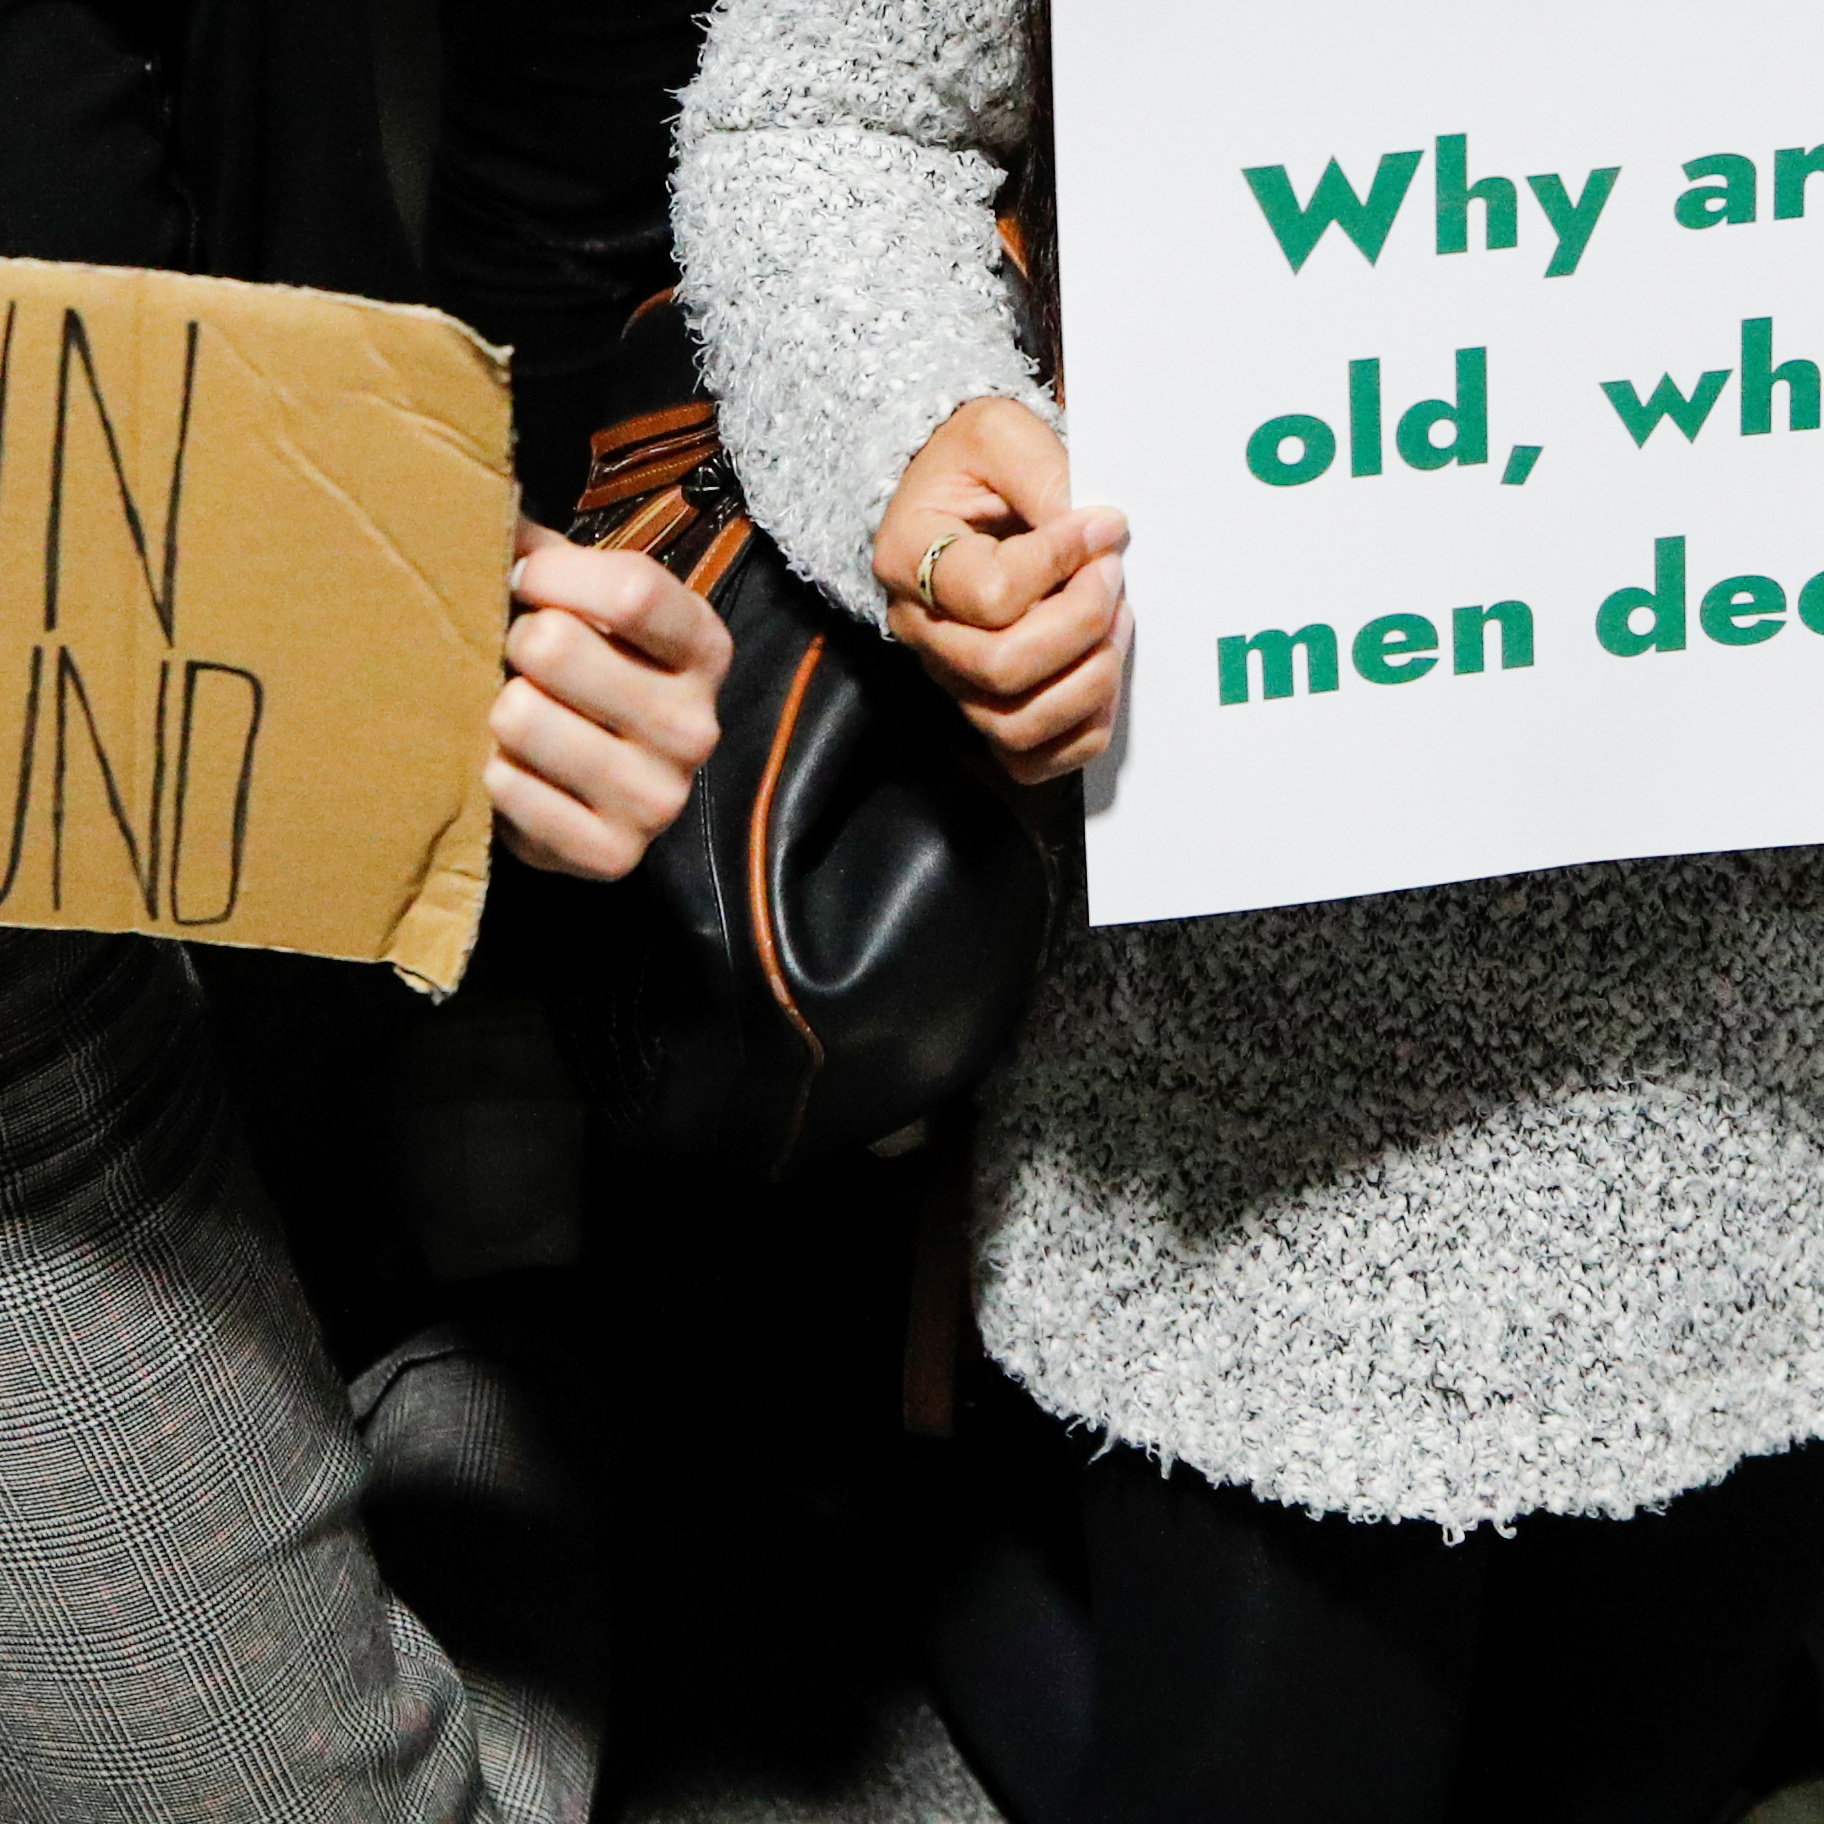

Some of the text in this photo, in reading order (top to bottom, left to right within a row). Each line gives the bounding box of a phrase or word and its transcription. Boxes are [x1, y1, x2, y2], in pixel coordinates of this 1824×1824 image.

[1244, 134, 1620, 278] Why
[1245, 348, 1543, 488] old,
[1216, 601, 1535, 706] men
